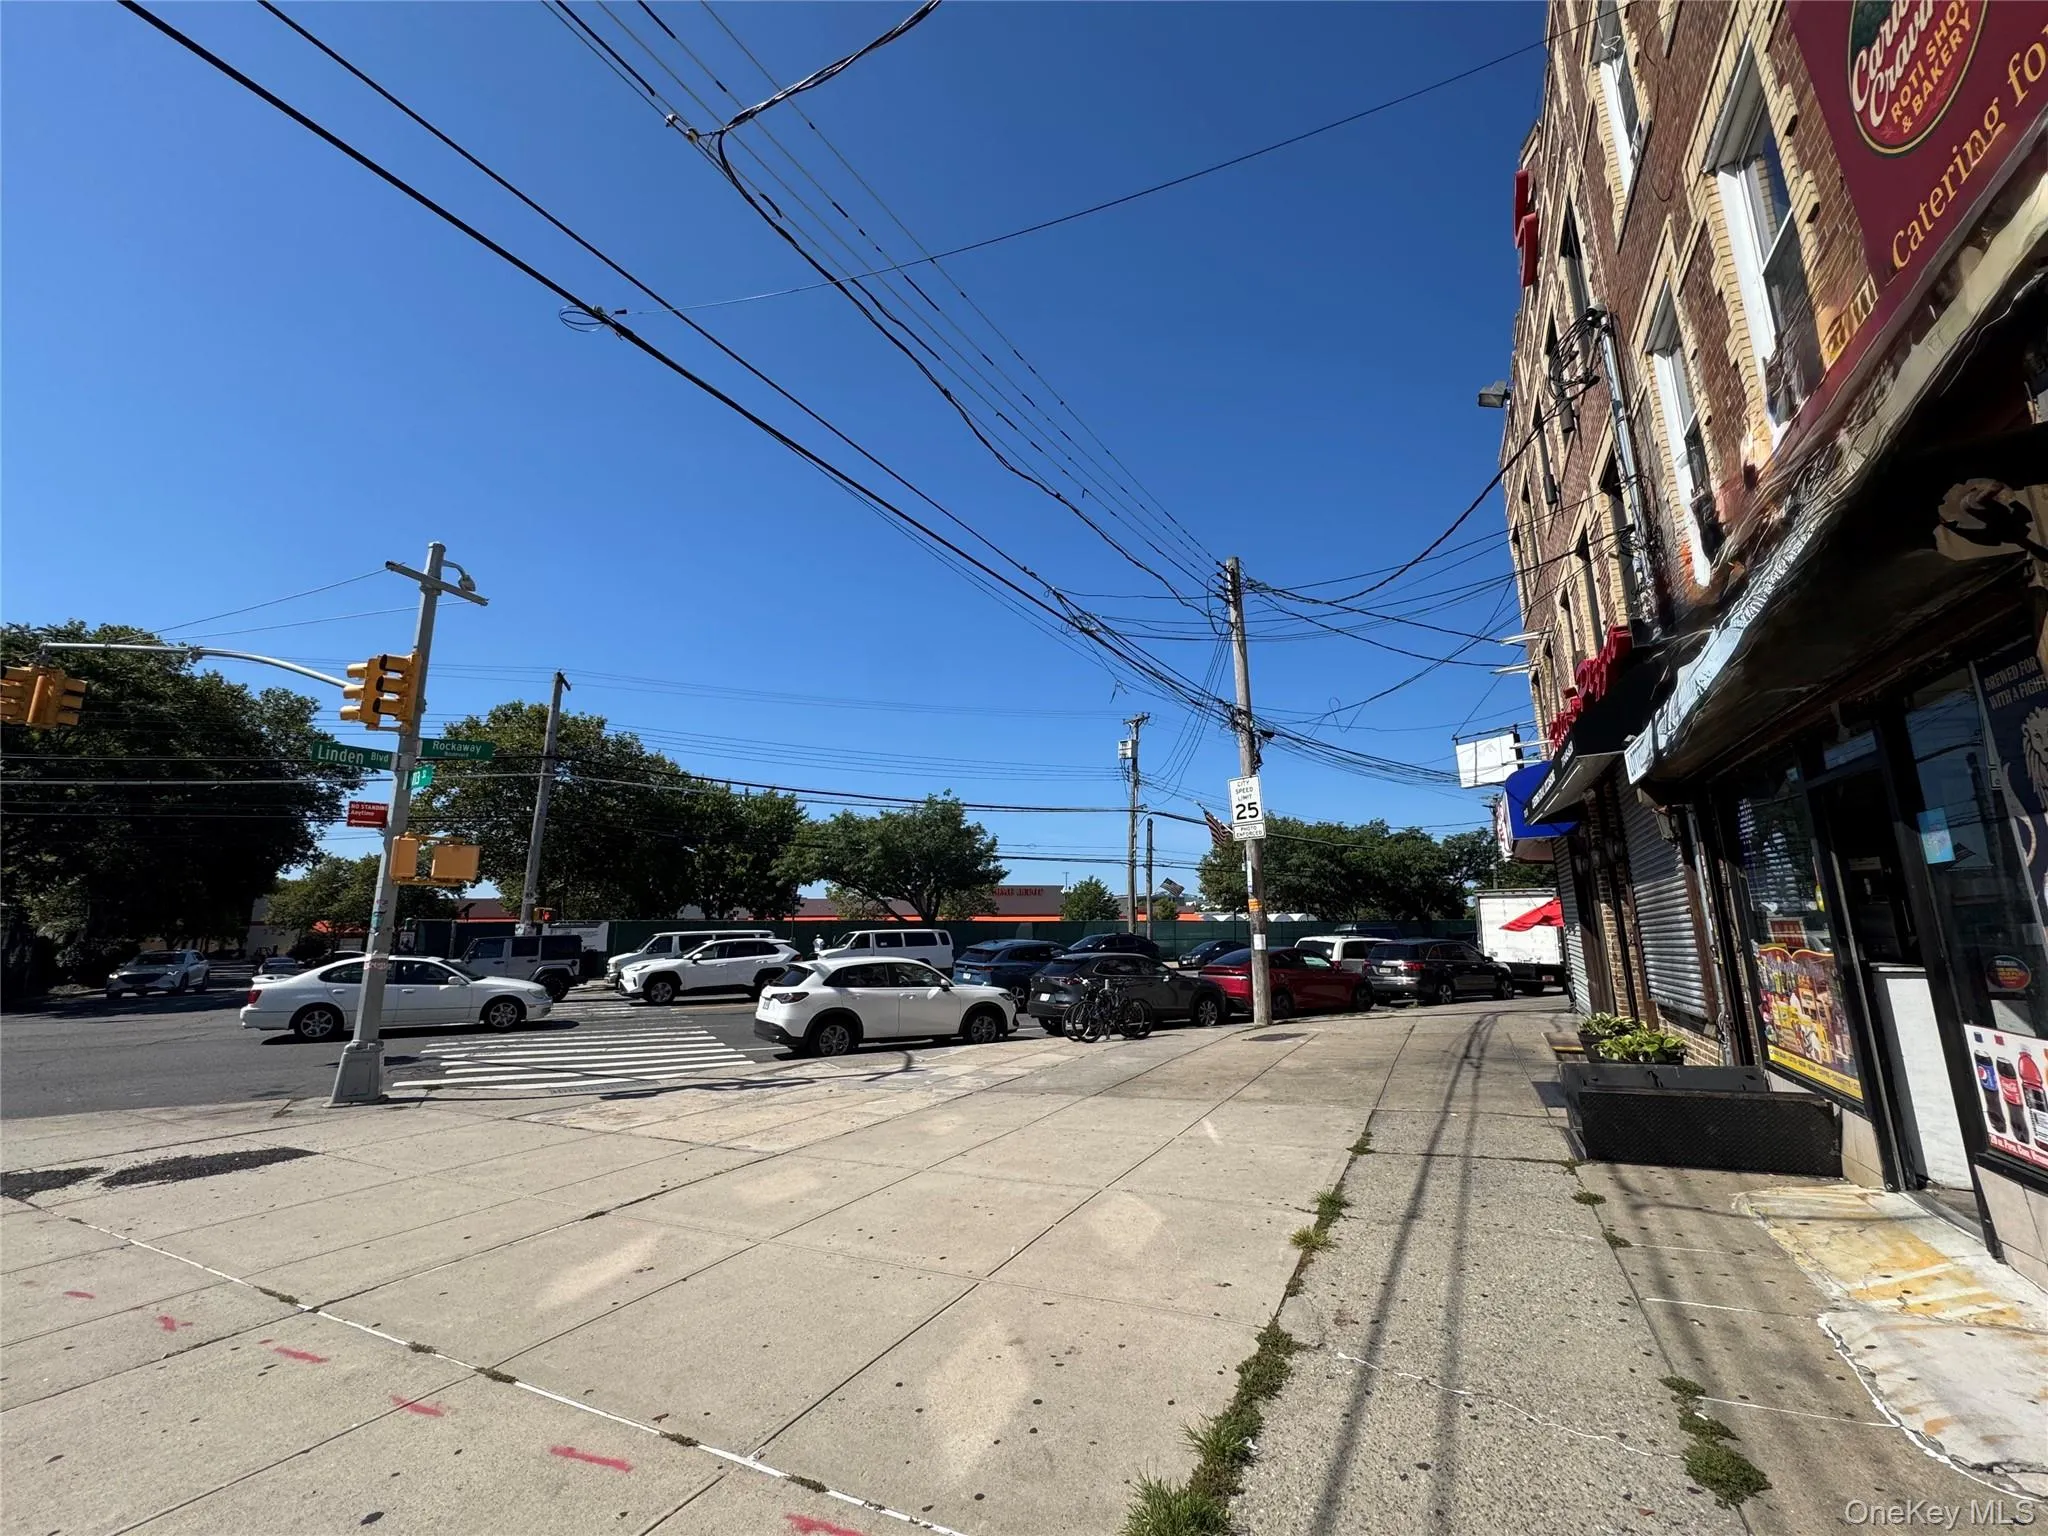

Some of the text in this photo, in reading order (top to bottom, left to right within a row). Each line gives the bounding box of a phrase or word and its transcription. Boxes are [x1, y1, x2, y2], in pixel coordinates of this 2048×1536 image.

[1902, 8, 1971, 134] & BAKERY
[1890, 61, 1925, 123] ROTI
[1892, 97, 2007, 270] Catering
[2018, 656, 2039, 676] FOR
[317, 744, 389, 765] Linden Blvd
[432, 740, 482, 755] Rockaway
[1235, 786, 1254, 795] SPEED
[1237, 793, 1252, 801] LIMIT
[1235, 801, 1259, 820] 25
